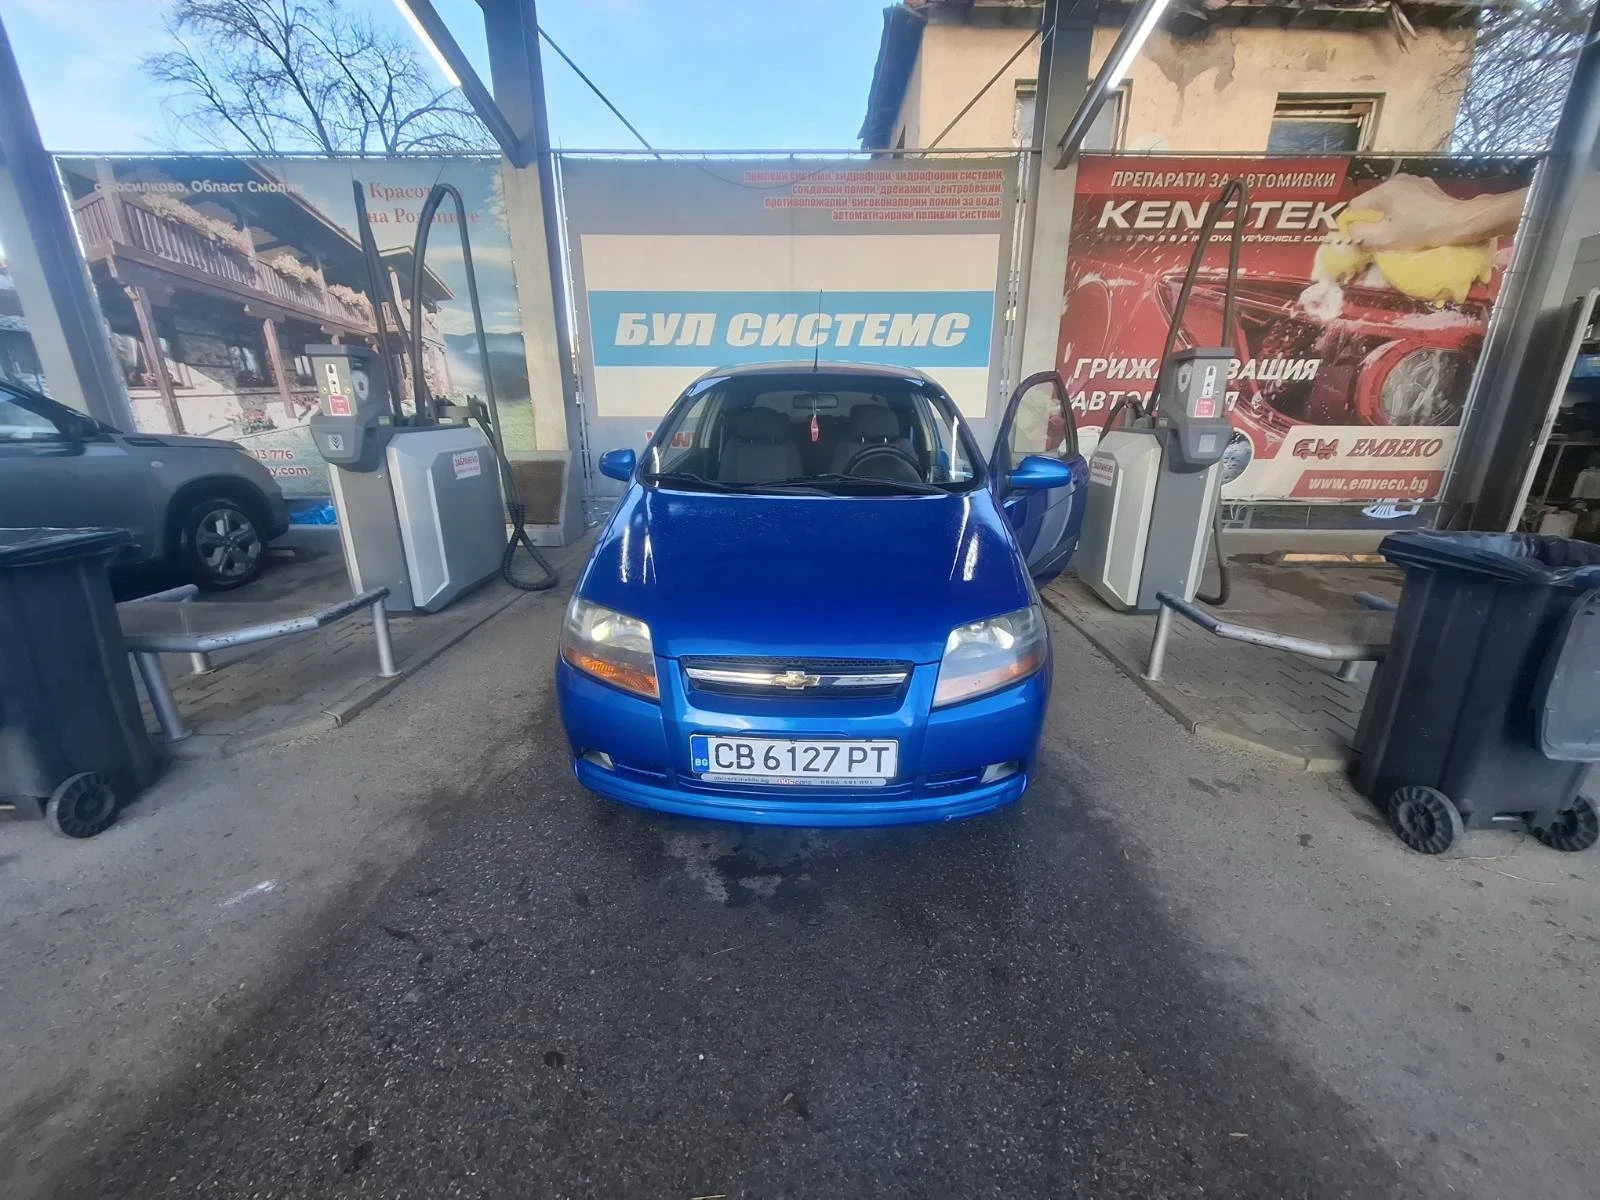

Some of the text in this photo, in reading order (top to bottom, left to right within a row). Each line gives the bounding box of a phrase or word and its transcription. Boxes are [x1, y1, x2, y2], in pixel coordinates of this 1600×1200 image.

[191, 179, 244, 193] Област
[1111, 171, 1337, 188] ПРЕПАРАТИ ЗА ВТОМИВКИ
[852, 197, 927, 208] високонапорни
[929, 196, 961, 207] помпи
[962, 196, 974, 207] за
[832, 210, 914, 221] автоматизирани
[959, 209, 1000, 220] системи
[614, 312, 971, 348] БУЛ СИСТЕМС
[1073, 358, 1159, 379] ГРИЖ
[269, 449, 294, 460] 776
[1308, 476, 1429, 494] www.emveco.bg
